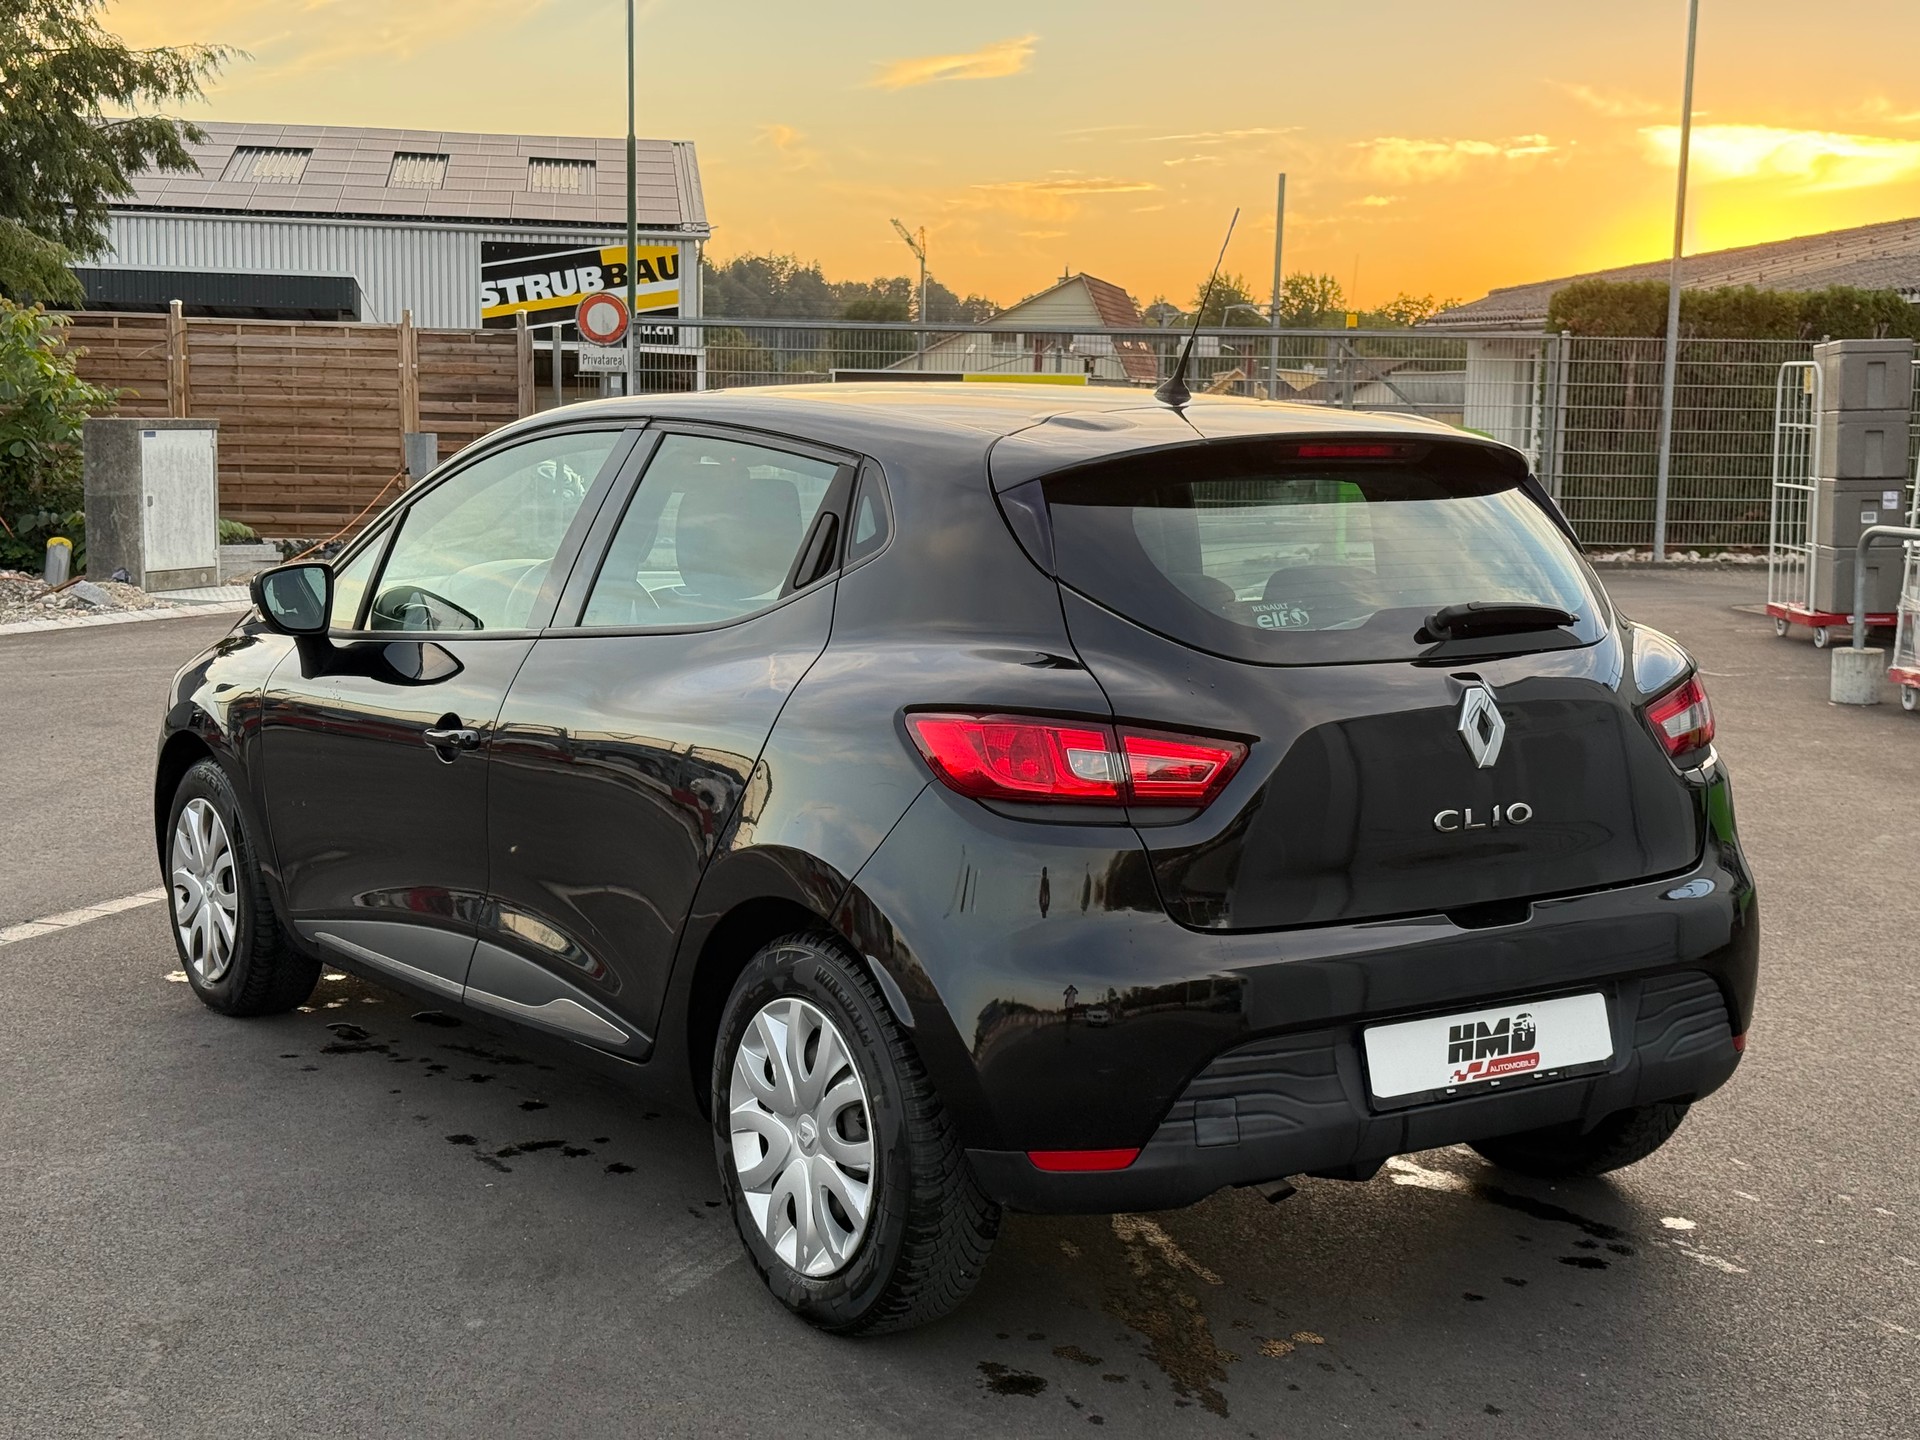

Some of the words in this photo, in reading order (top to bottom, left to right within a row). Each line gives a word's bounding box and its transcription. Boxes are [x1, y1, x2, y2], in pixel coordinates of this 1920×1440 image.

[582, 353, 625, 366] Privatareal
[1252, 603, 1288, 612] RENAULT
[1257, 610, 1290, 628] elf
[1433, 802, 1533, 833] CLIO
[1489, 1059, 1536, 1073] AUTOMOBILE
